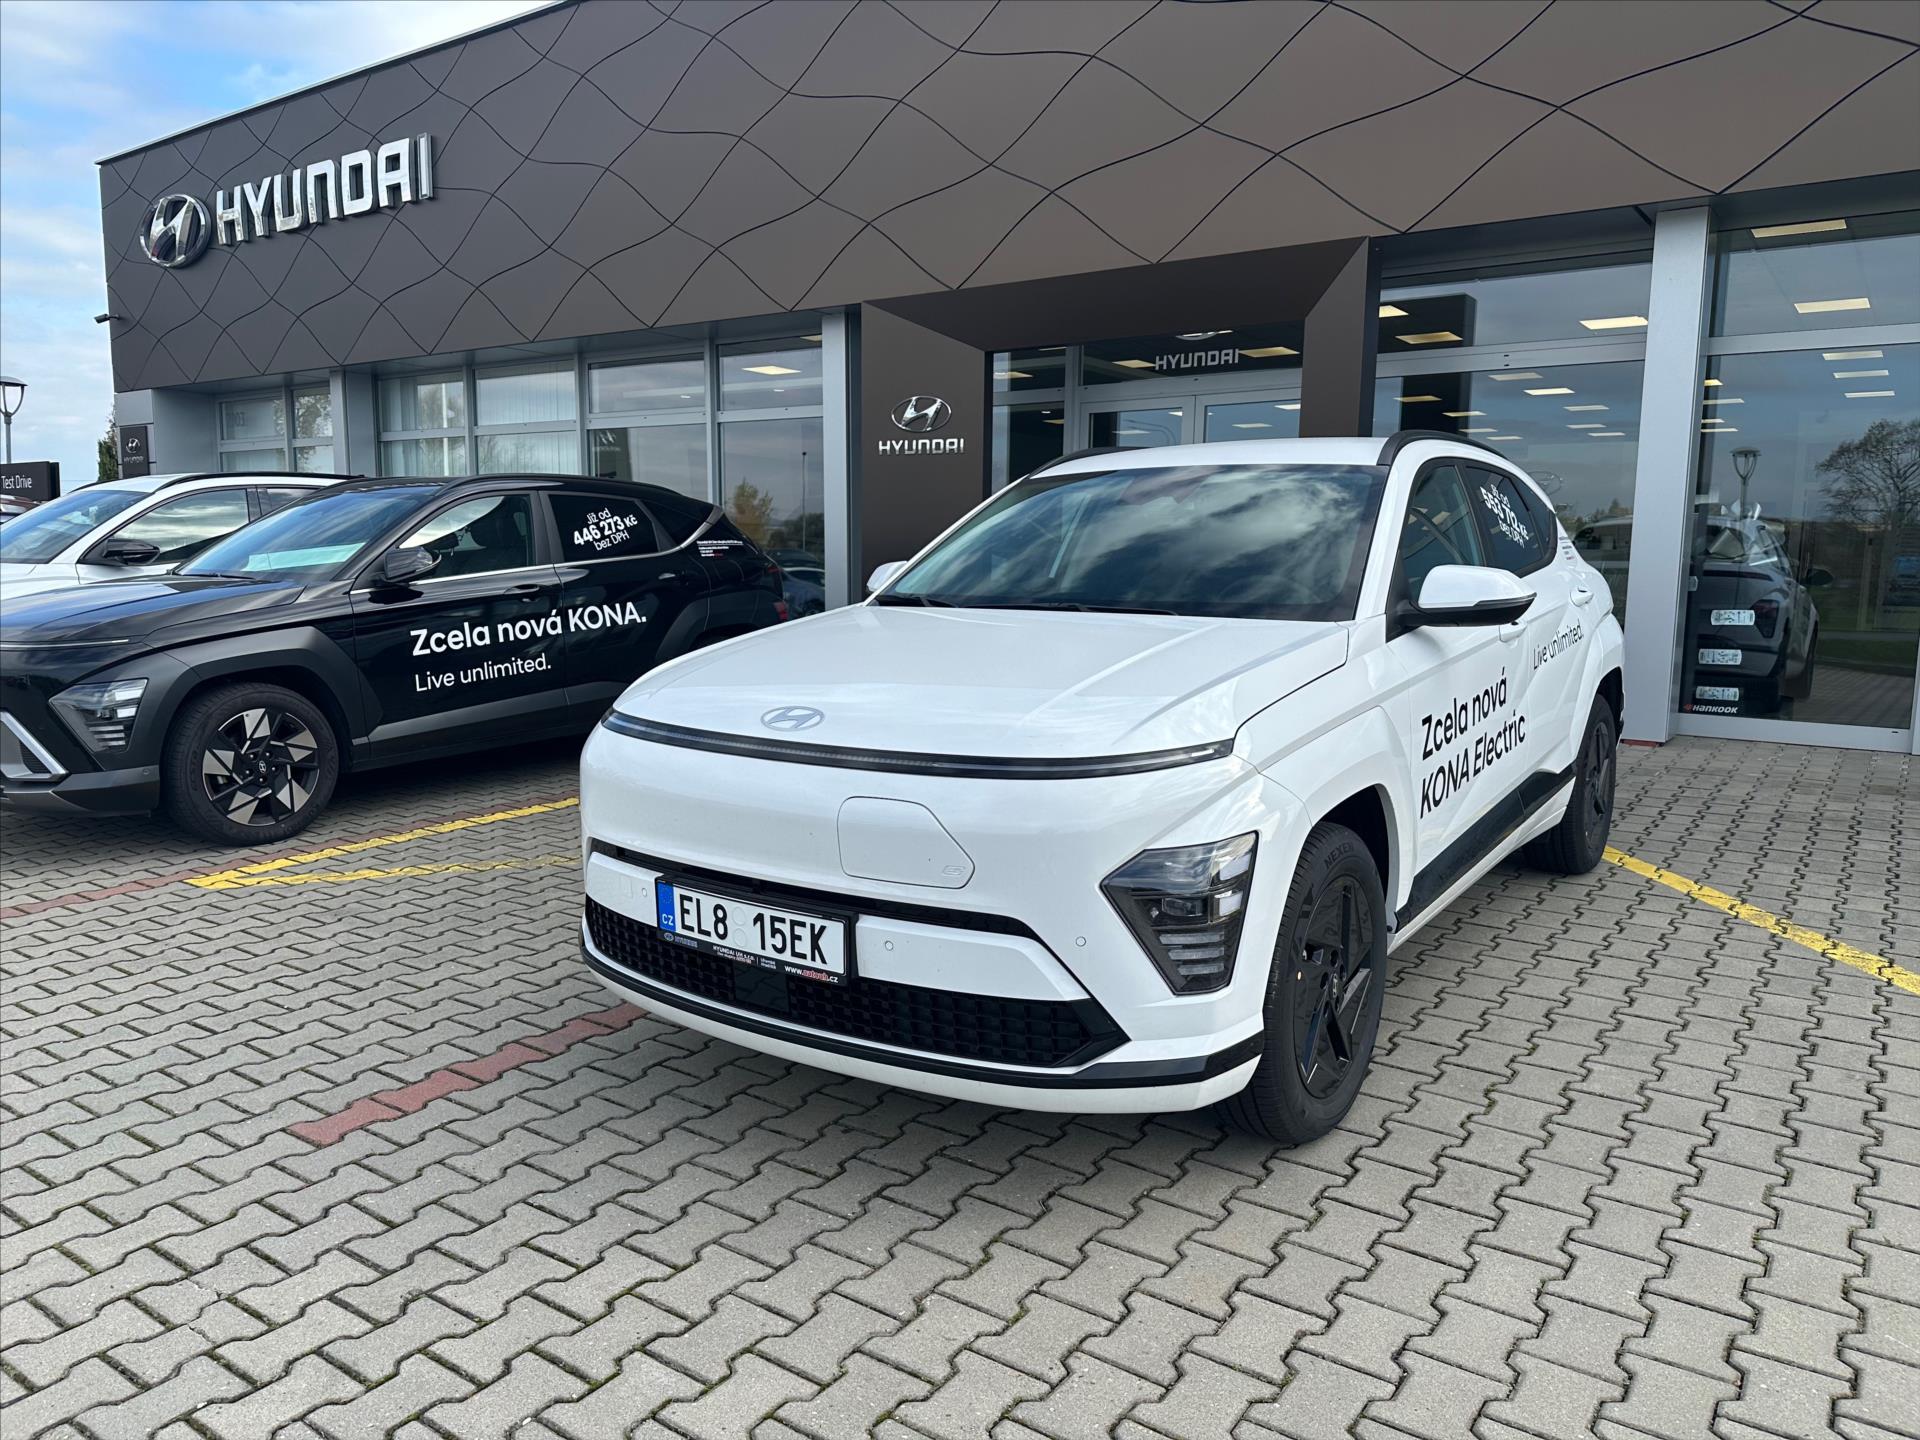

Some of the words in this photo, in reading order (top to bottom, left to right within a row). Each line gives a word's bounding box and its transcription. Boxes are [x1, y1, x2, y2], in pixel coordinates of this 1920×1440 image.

[216, 132, 433, 245] HYUNDAI
[1155, 349, 1239, 371] HYUNDAI
[878, 438, 964, 456] HYUNDAI
[1, 475, 14, 489] Test
[15, 474, 32, 489] Drive
[598, 507, 611, 520] od
[574, 525, 601, 545] 446
[600, 515, 625, 536] 273
[623, 514, 638, 528] Kč
[593, 538, 612, 551] bez
[610, 529, 630, 544] DPH
[409, 618, 491, 657] Zcela
[497, 609, 562, 643] nová
[568, 601, 647, 633] KONA.
[1533, 644, 1548, 670] Live
[415, 670, 455, 692] Live
[460, 653, 552, 685] unlimited.
[1422, 698, 1468, 760] Zcela
[1472, 666, 1507, 727] nová
[1420, 747, 1469, 819] KONA
[1473, 709, 1526, 778] Electric
[662, 913, 674, 926] CZ
[679, 893, 728, 940] EL8
[753, 912, 828, 965] 15EK
